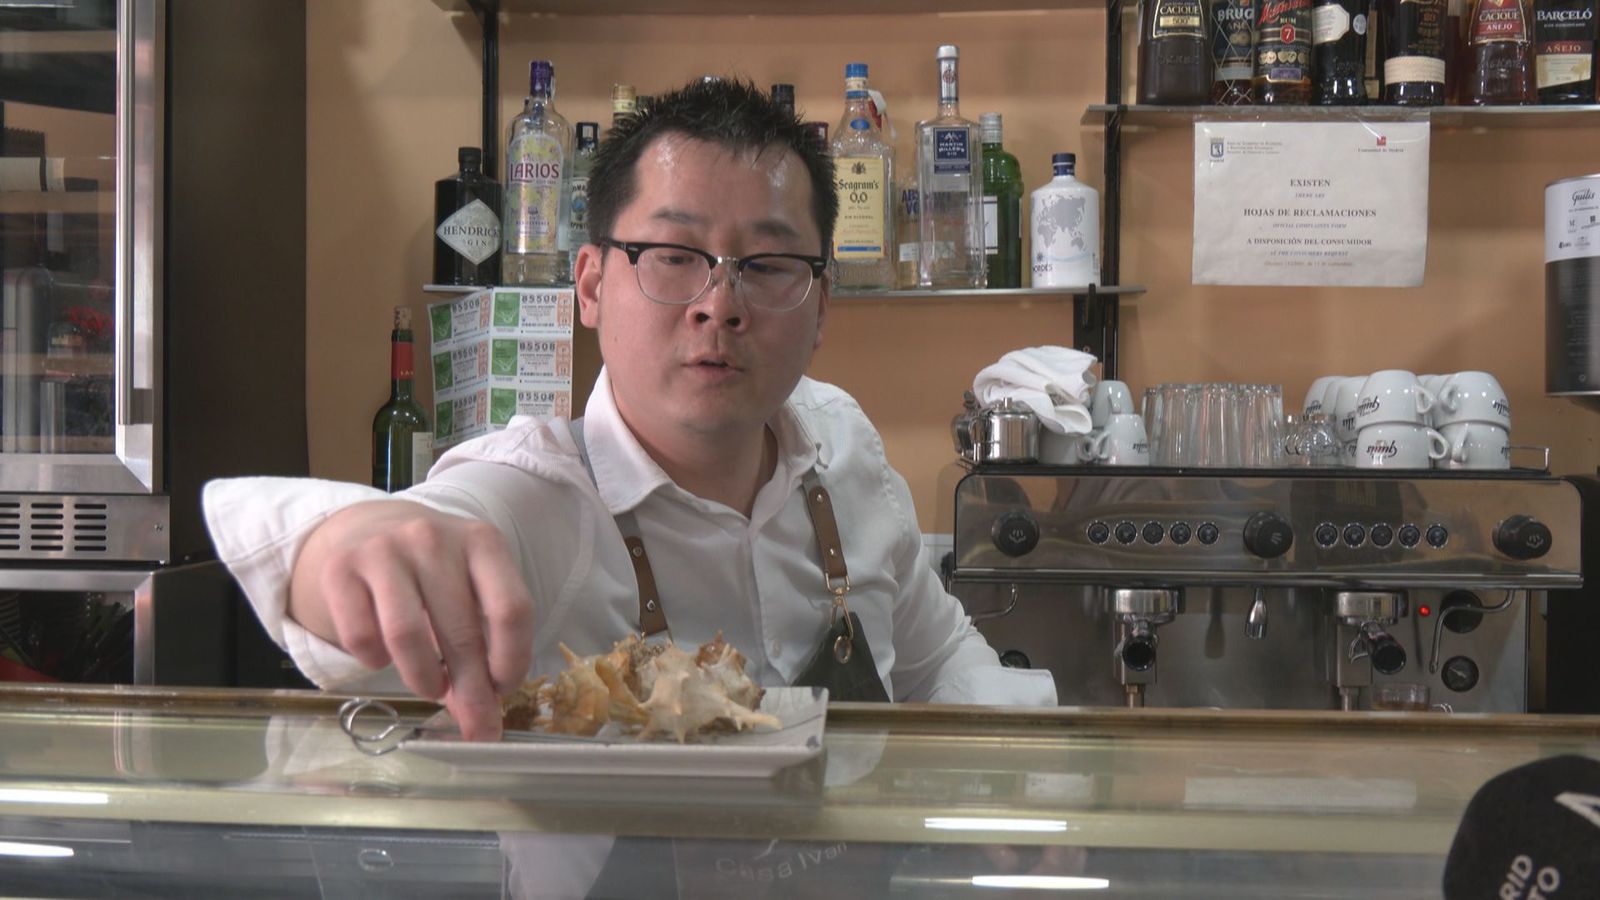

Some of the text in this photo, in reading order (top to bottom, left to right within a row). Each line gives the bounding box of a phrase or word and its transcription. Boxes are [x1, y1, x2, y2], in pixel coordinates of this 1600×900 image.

[1159, 5, 1200, 15] CACIQUE
[1217, 8, 1254, 21] BRUG
[1536, 8, 1593, 22] BARCELÓ
[1479, 10, 1520, 21] CACIQUE
[1486, 23, 1513, 31] AÑEJO
[1284, 28, 1292, 41] 7
[1545, 43, 1581, 53] AÑEJO
[510, 163, 560, 182] LARIOS
[839, 179, 880, 193] Seagram's
[1290, 179, 1331, 187] EXISTEN
[1243, 208, 1377, 217] HOJAS DE RECLAMACIONES
[1254, 237, 1302, 245] DISPOSICIÓN
[521, 294, 558, 304] 85508
[519, 342, 556, 352] 85508
[518, 392, 555, 402] 85508
[715, 857, 793, 882] Casa
[1499, 854, 1533, 900] RID
